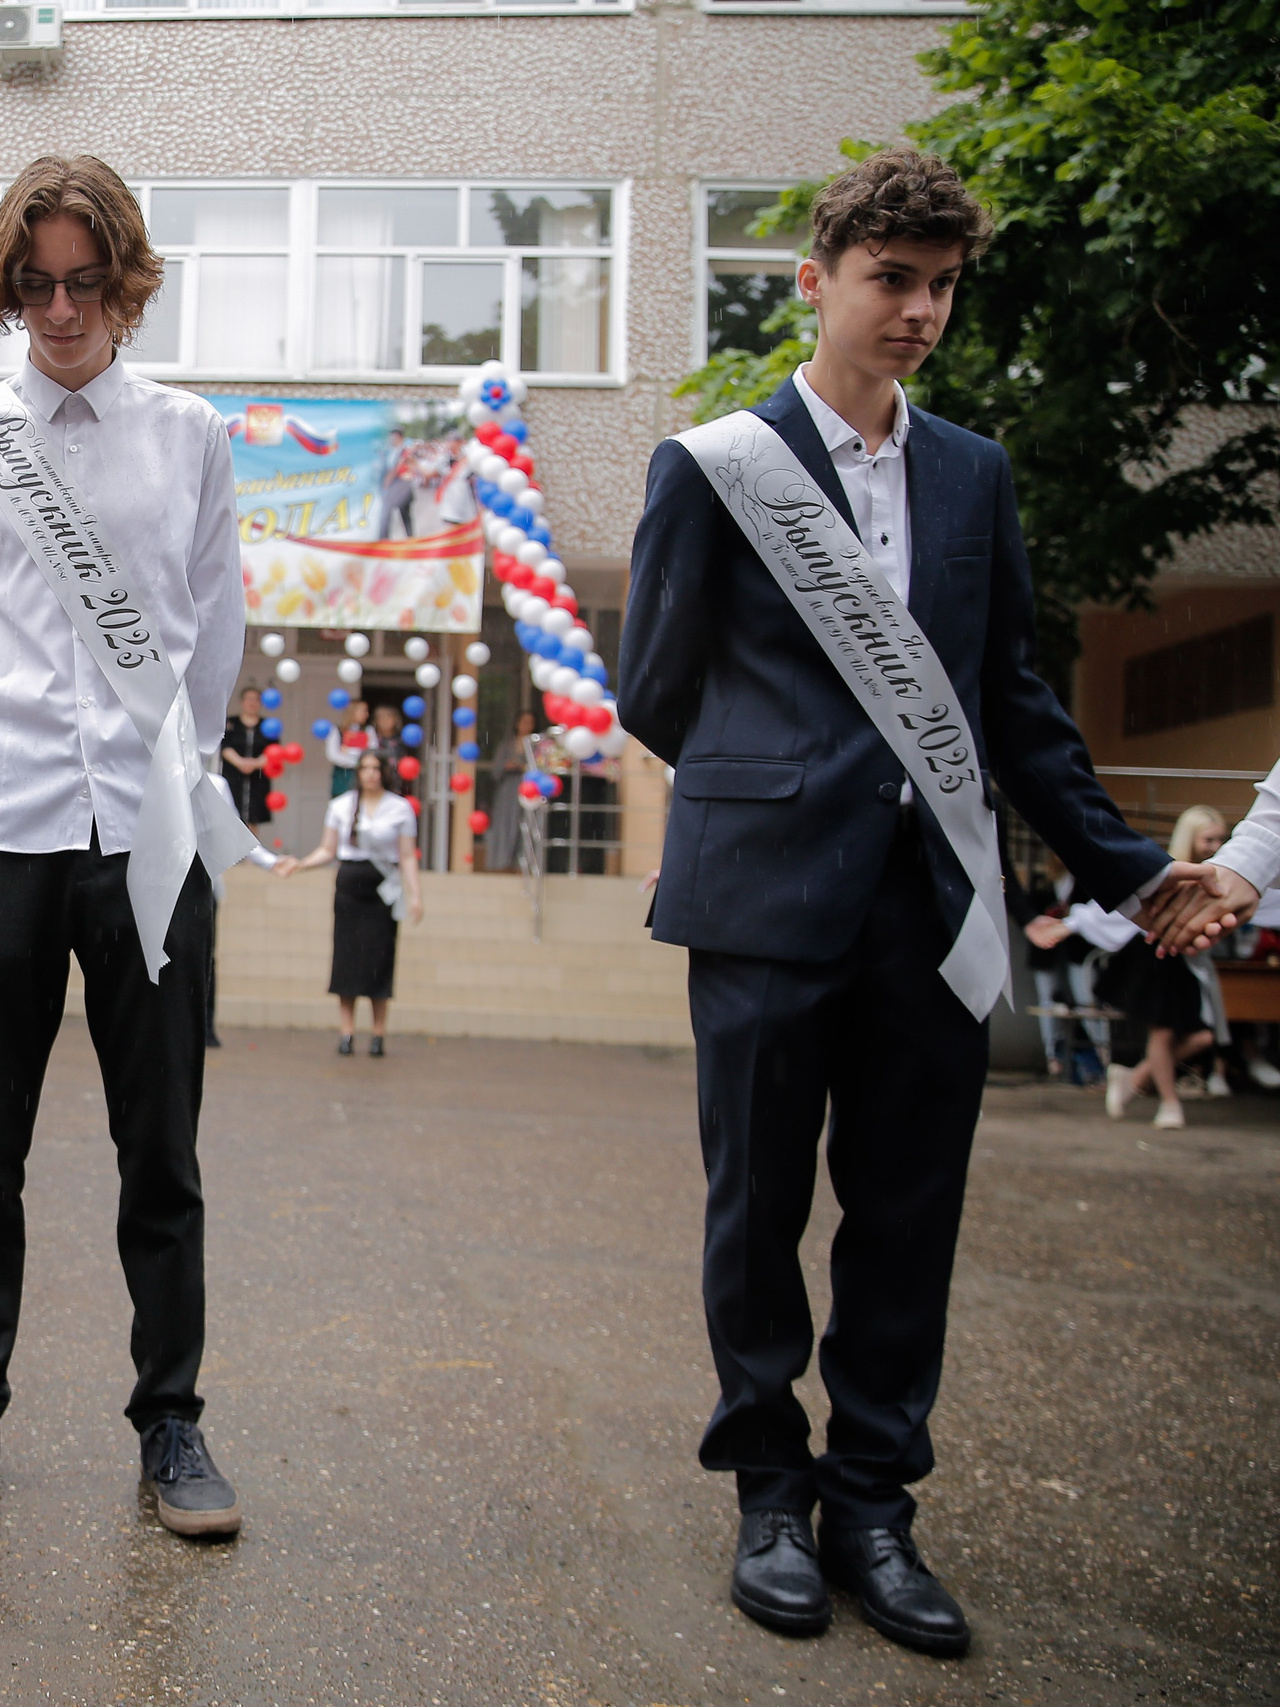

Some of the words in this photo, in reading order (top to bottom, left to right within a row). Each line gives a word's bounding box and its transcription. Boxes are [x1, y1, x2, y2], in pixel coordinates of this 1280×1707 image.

[234, 466, 357, 496] видания,
[78, 514, 120, 576] Дмитрий
[238, 492, 373, 544] ОЛА!
[80, 588, 162, 669] 2023
[753, 467, 922, 699] Выпускник
[897, 703, 977, 794] 2023
[839, 545, 900, 630] Ходкевич
[896, 633, 925, 662] Ян
